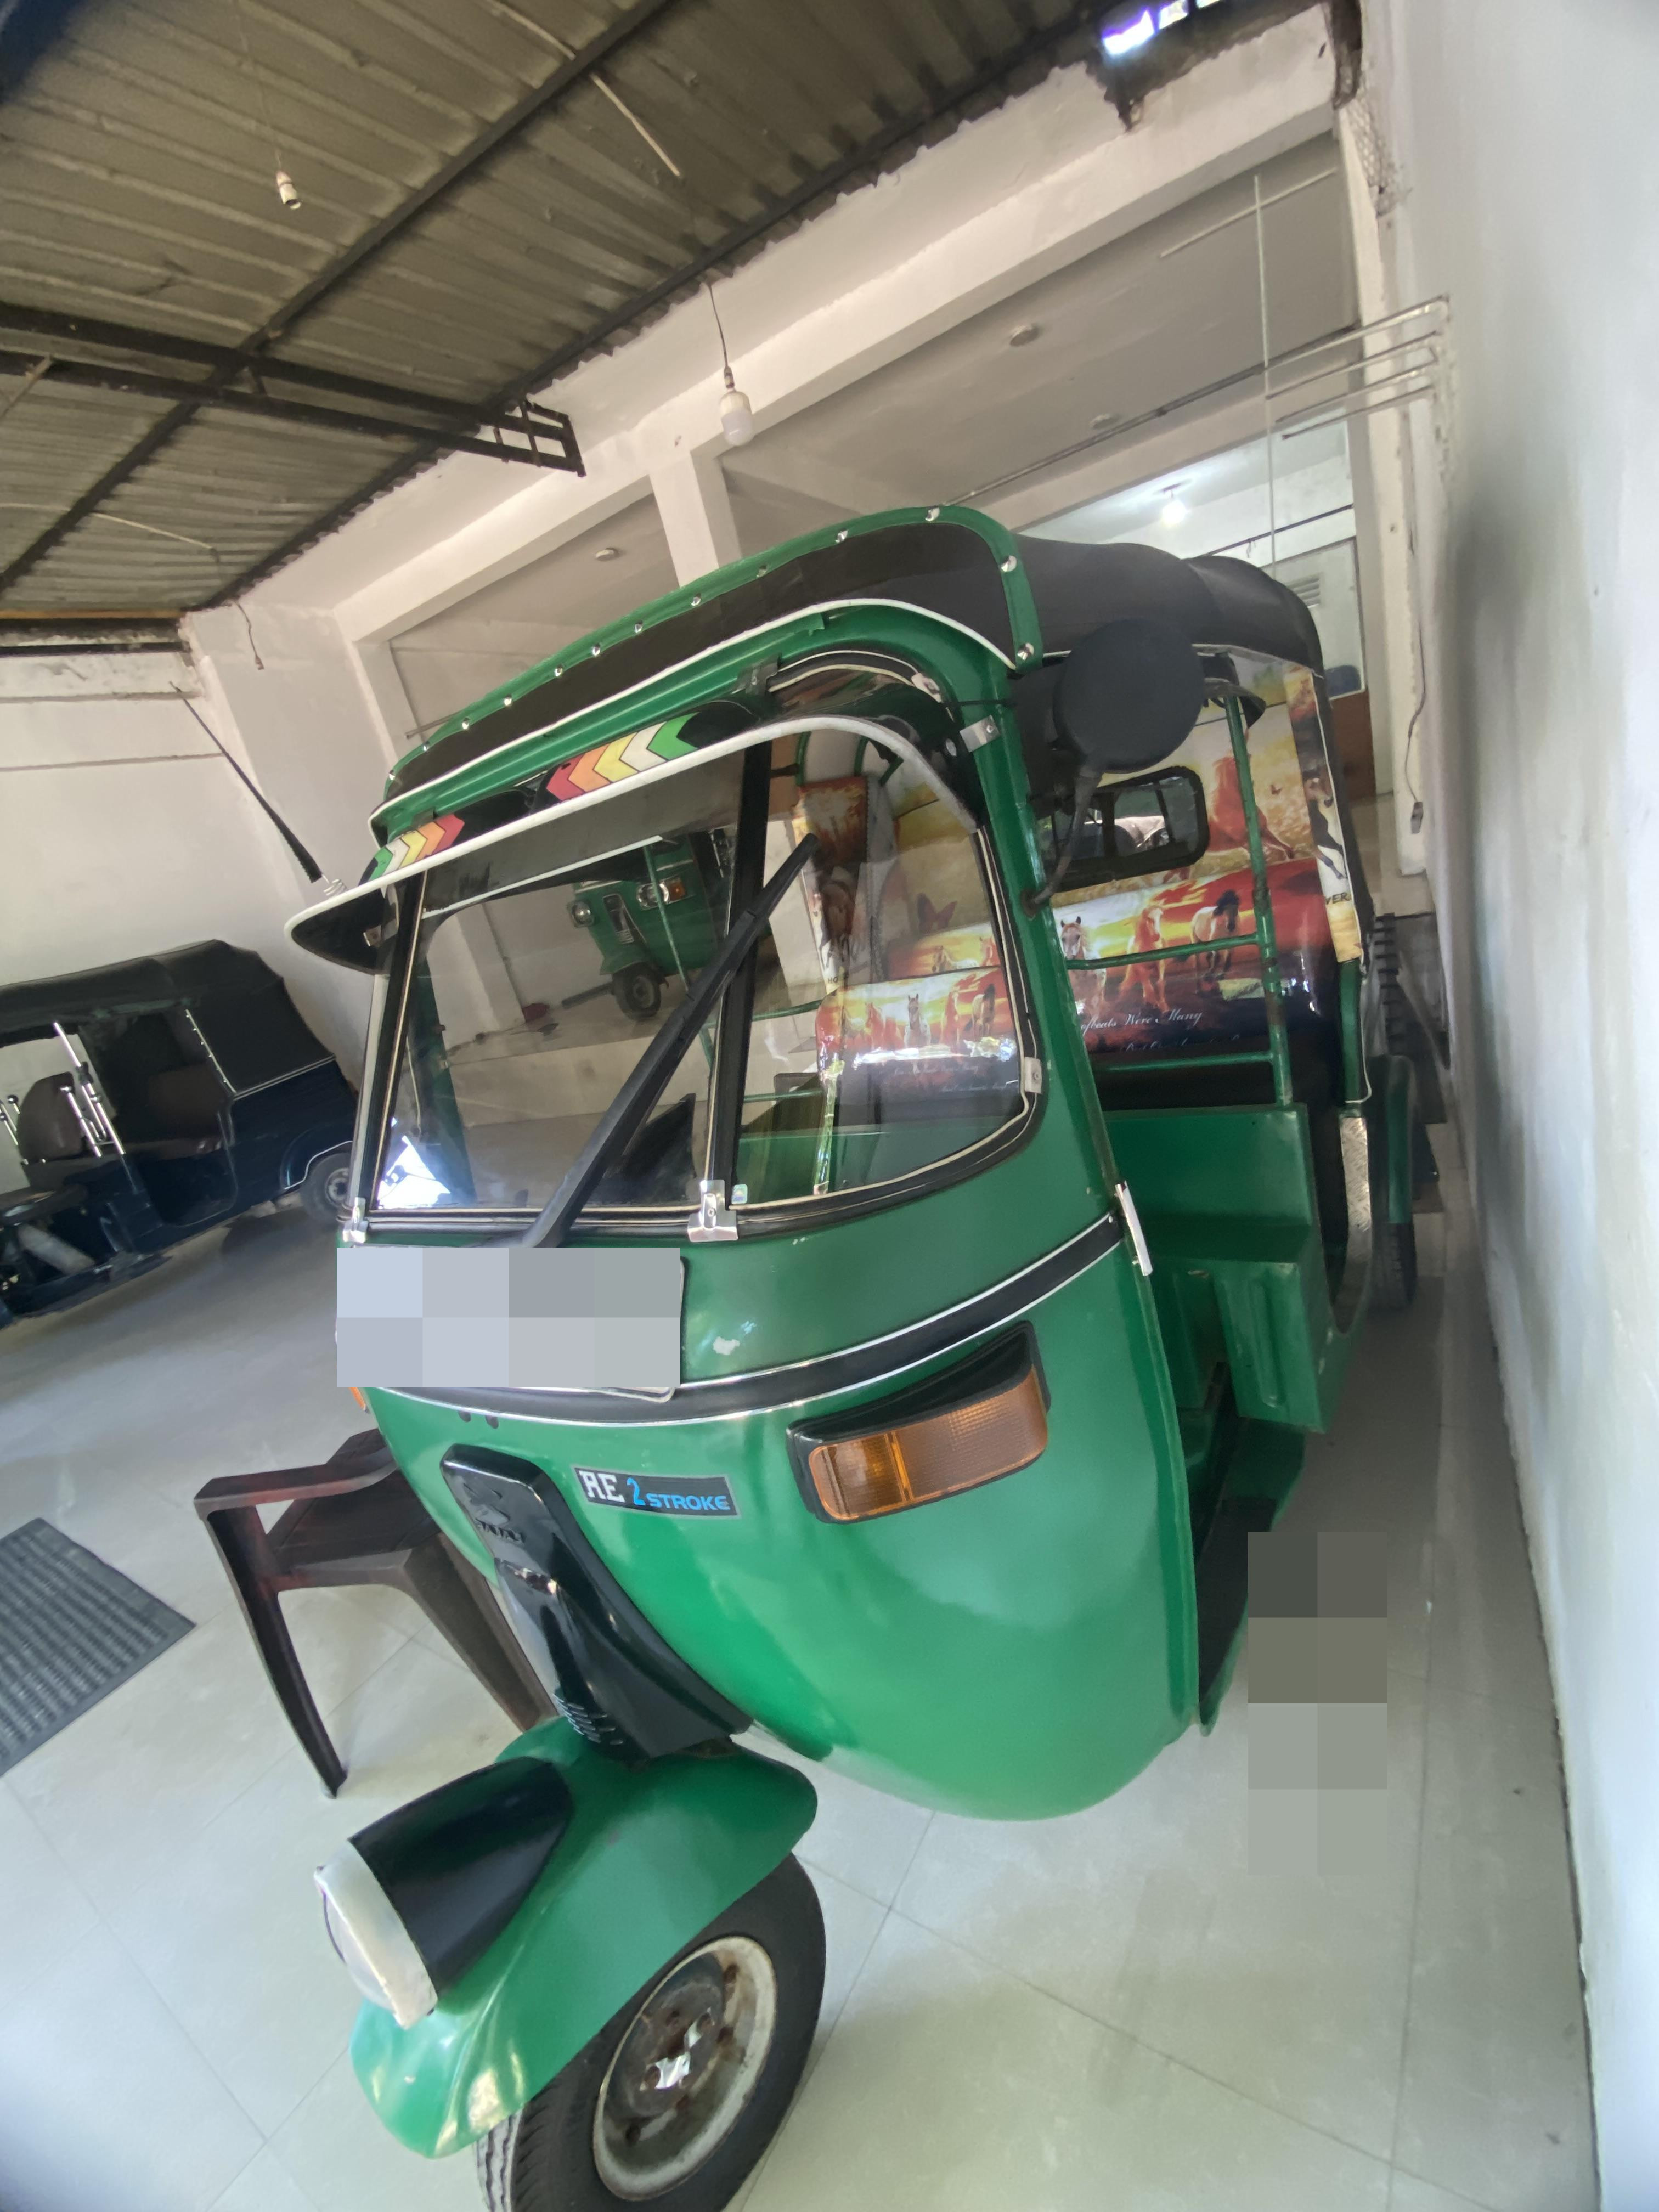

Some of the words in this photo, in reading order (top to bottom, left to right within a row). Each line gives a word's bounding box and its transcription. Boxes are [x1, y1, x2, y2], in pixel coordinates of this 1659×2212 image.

[578, 1470, 625, 1503] RE
[627, 1477, 646, 1506] 2
[646, 1493, 731, 1511] STROKE
